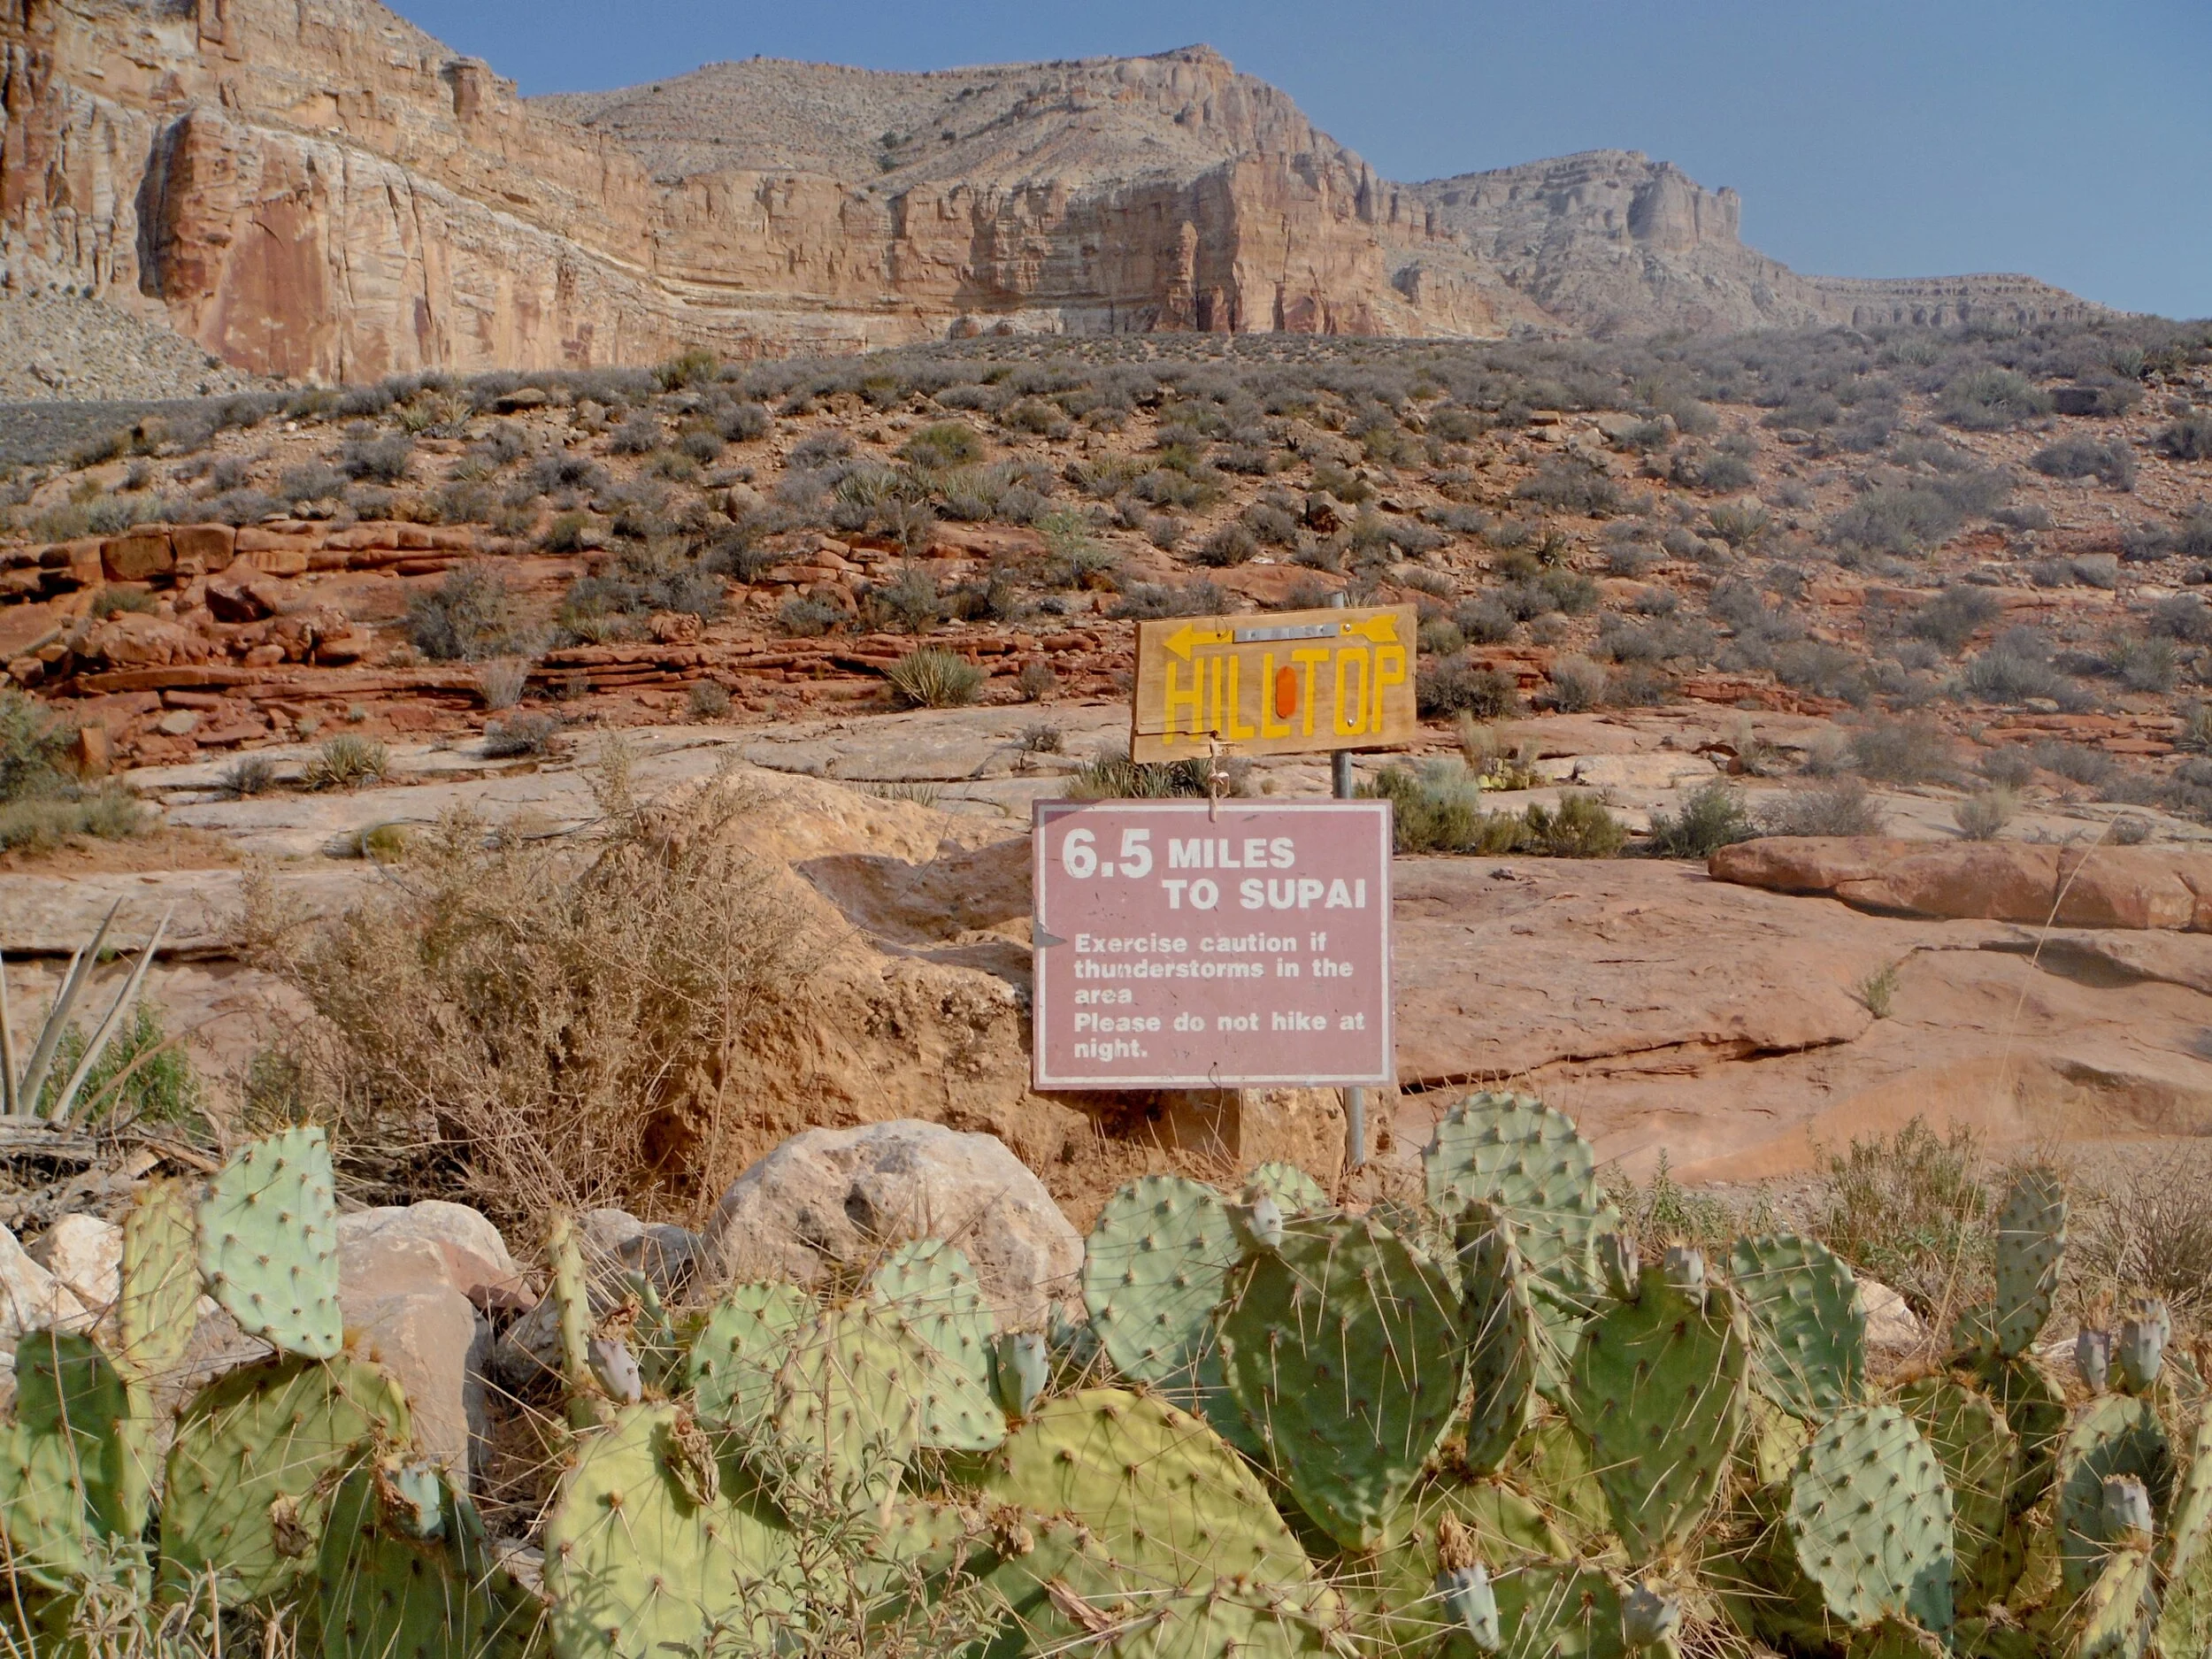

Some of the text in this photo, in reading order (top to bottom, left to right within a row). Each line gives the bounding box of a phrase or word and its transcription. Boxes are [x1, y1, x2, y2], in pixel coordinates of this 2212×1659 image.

[1161, 645, 1406, 745] HILLTOP
[1062, 828, 1295, 879] 6.5 MILES
[1162, 878, 1365, 910] TO SUPAI
[1075, 932, 1327, 953] Exercise caution if
[1074, 957, 1354, 979] thunderstorms in the
[1074, 988, 1133, 1004] area
[1074, 1011, 1365, 1033] Please do not hike at
[1074, 1039, 1148, 1062] night.
